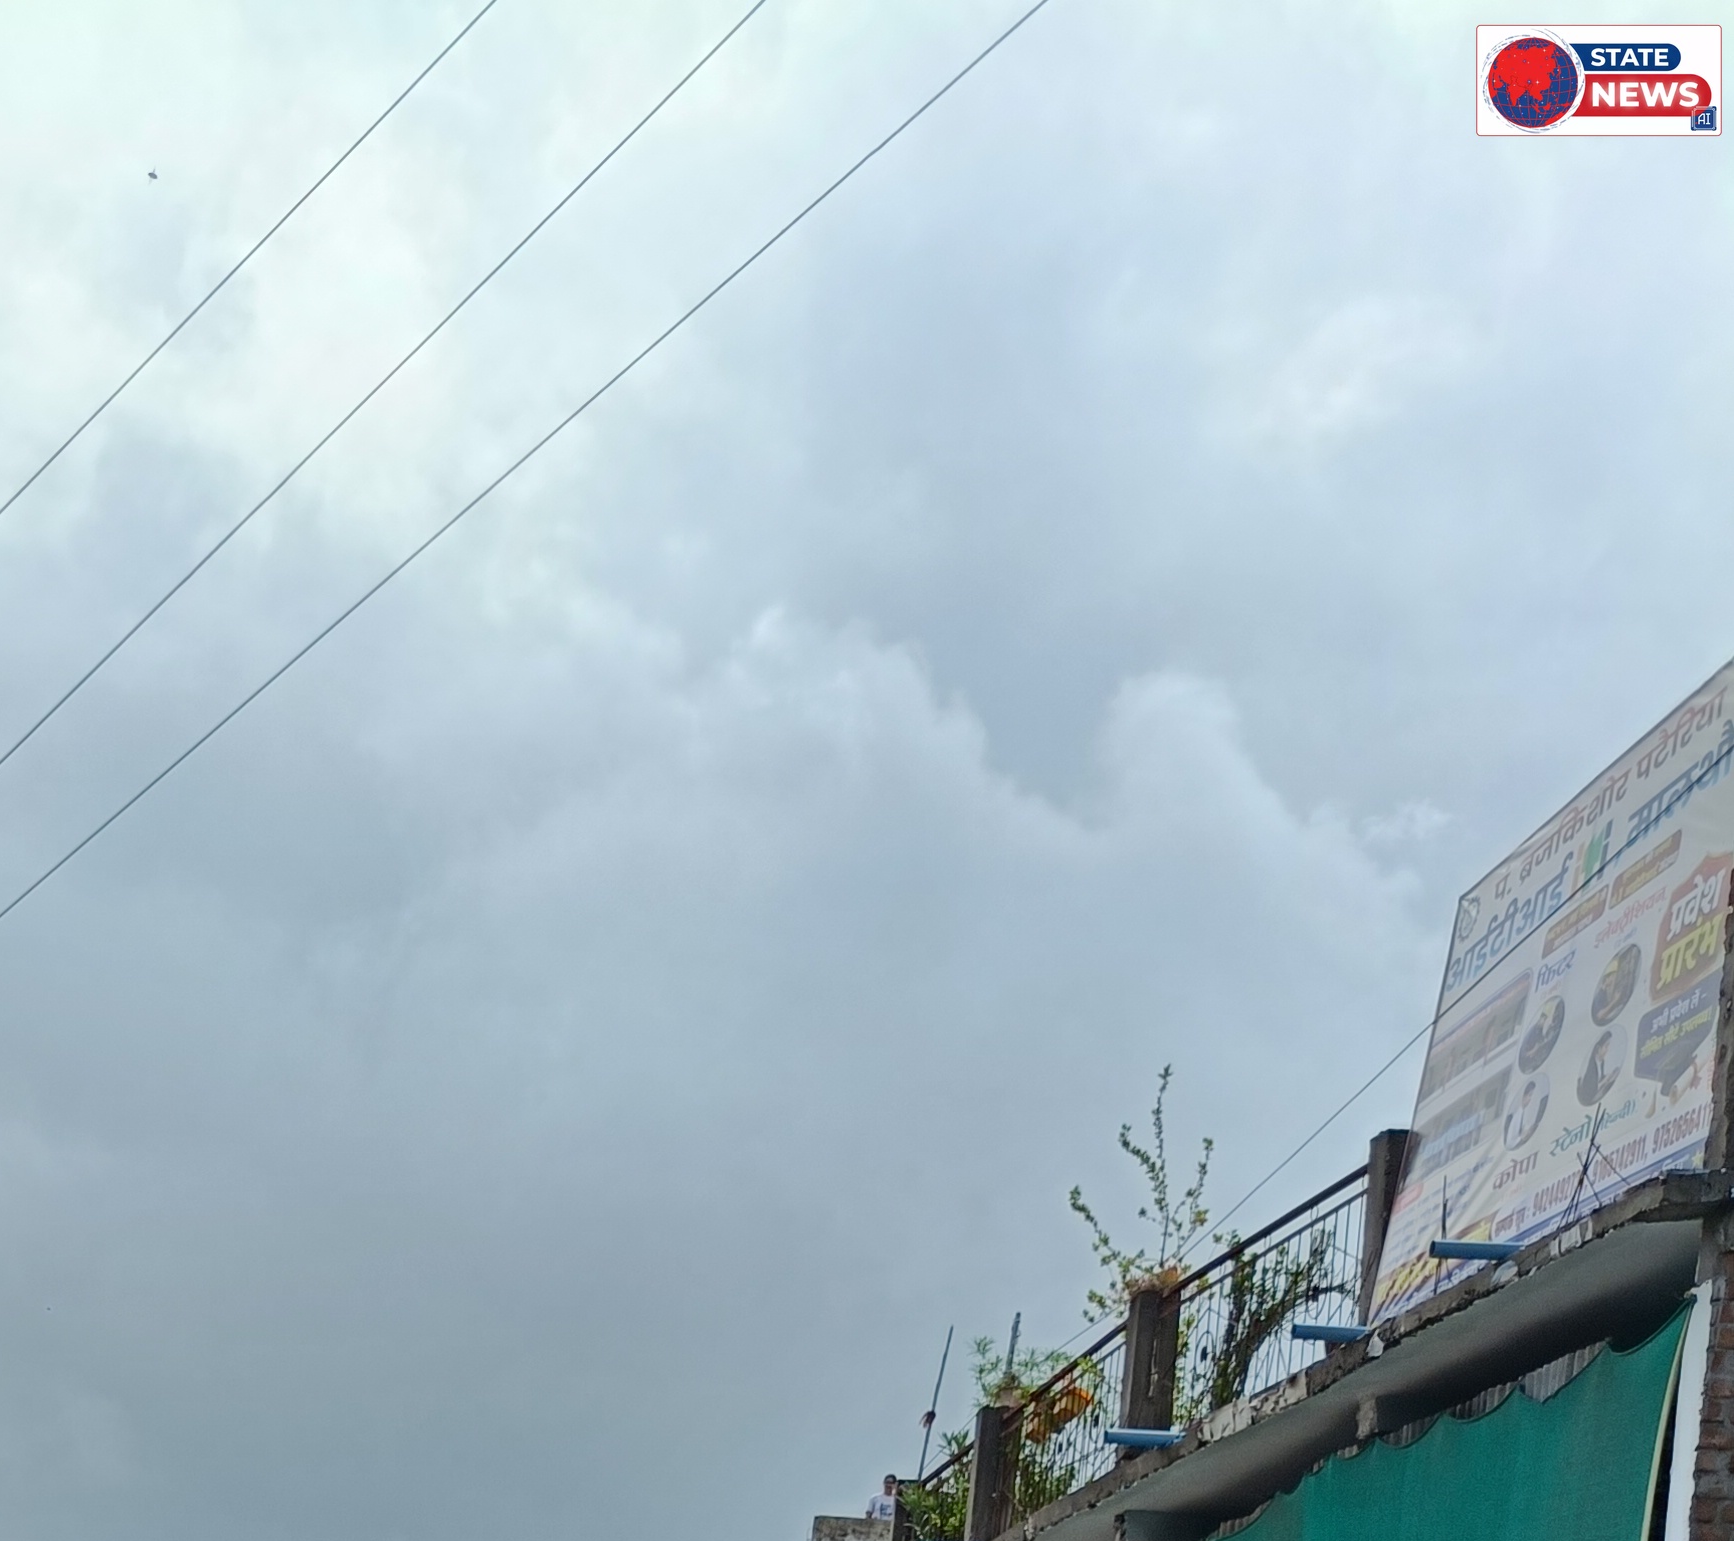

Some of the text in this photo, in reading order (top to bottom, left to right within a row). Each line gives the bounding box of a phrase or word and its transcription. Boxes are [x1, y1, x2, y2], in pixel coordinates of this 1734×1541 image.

[1666, 866, 1727, 942] प्रवेश
[1656, 910, 1726, 990] प्रारंभ
[1493, 1151, 1539, 1190] कोपा
